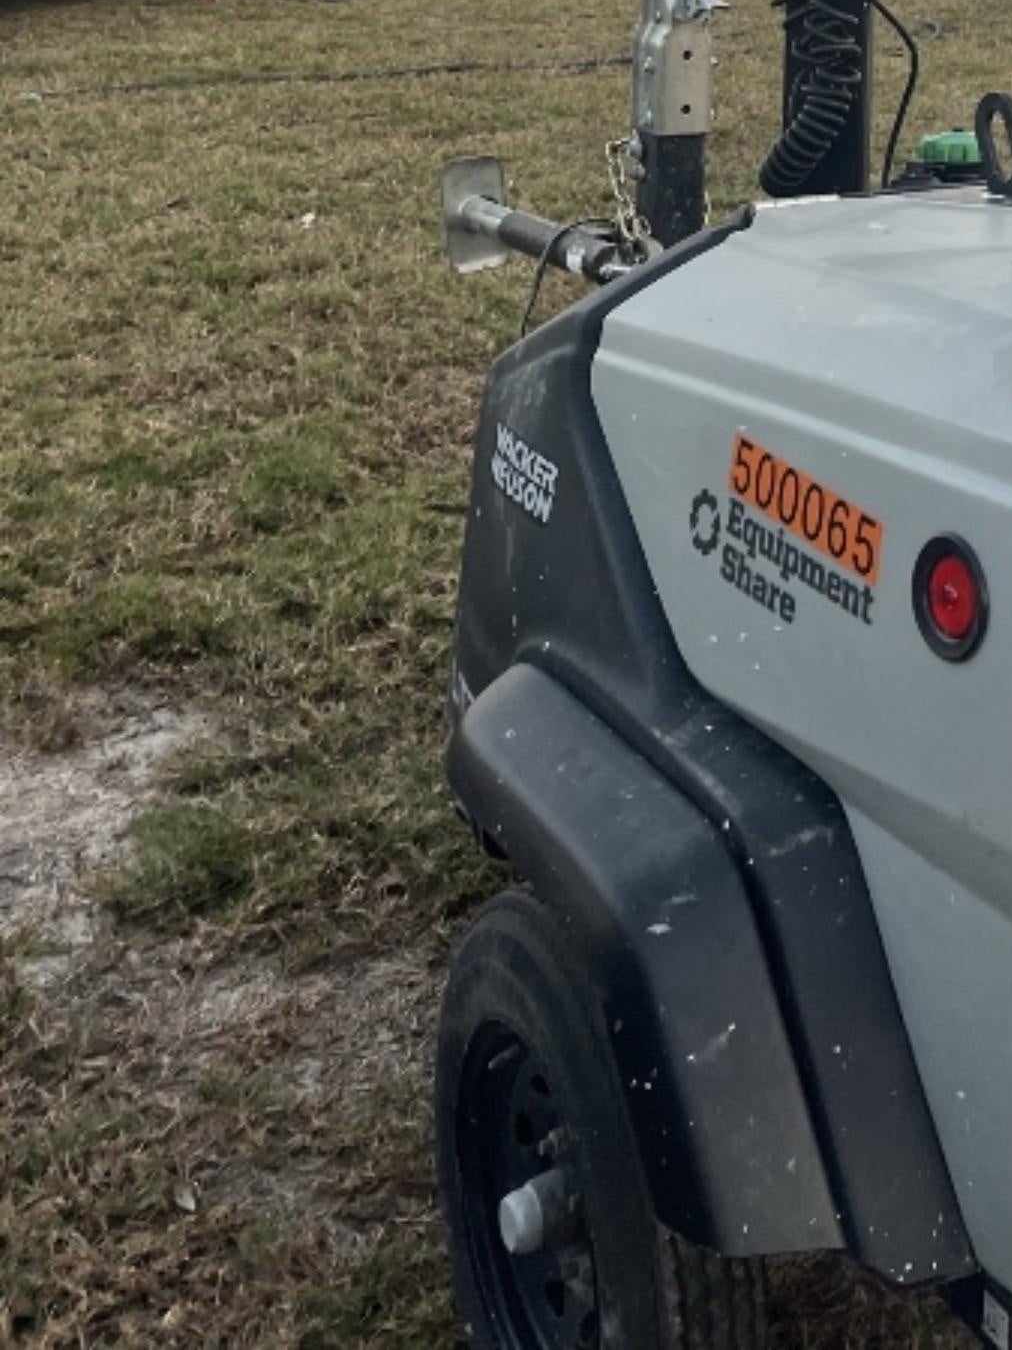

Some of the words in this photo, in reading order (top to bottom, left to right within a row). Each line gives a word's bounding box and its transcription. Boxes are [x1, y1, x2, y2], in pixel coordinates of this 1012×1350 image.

[490, 449, 554, 524] NEUSON
[496, 421, 560, 497] WACKER
[733, 437, 878, 577] 500065
[719, 543, 798, 624] Share
[725, 497, 874, 626] Equipment
